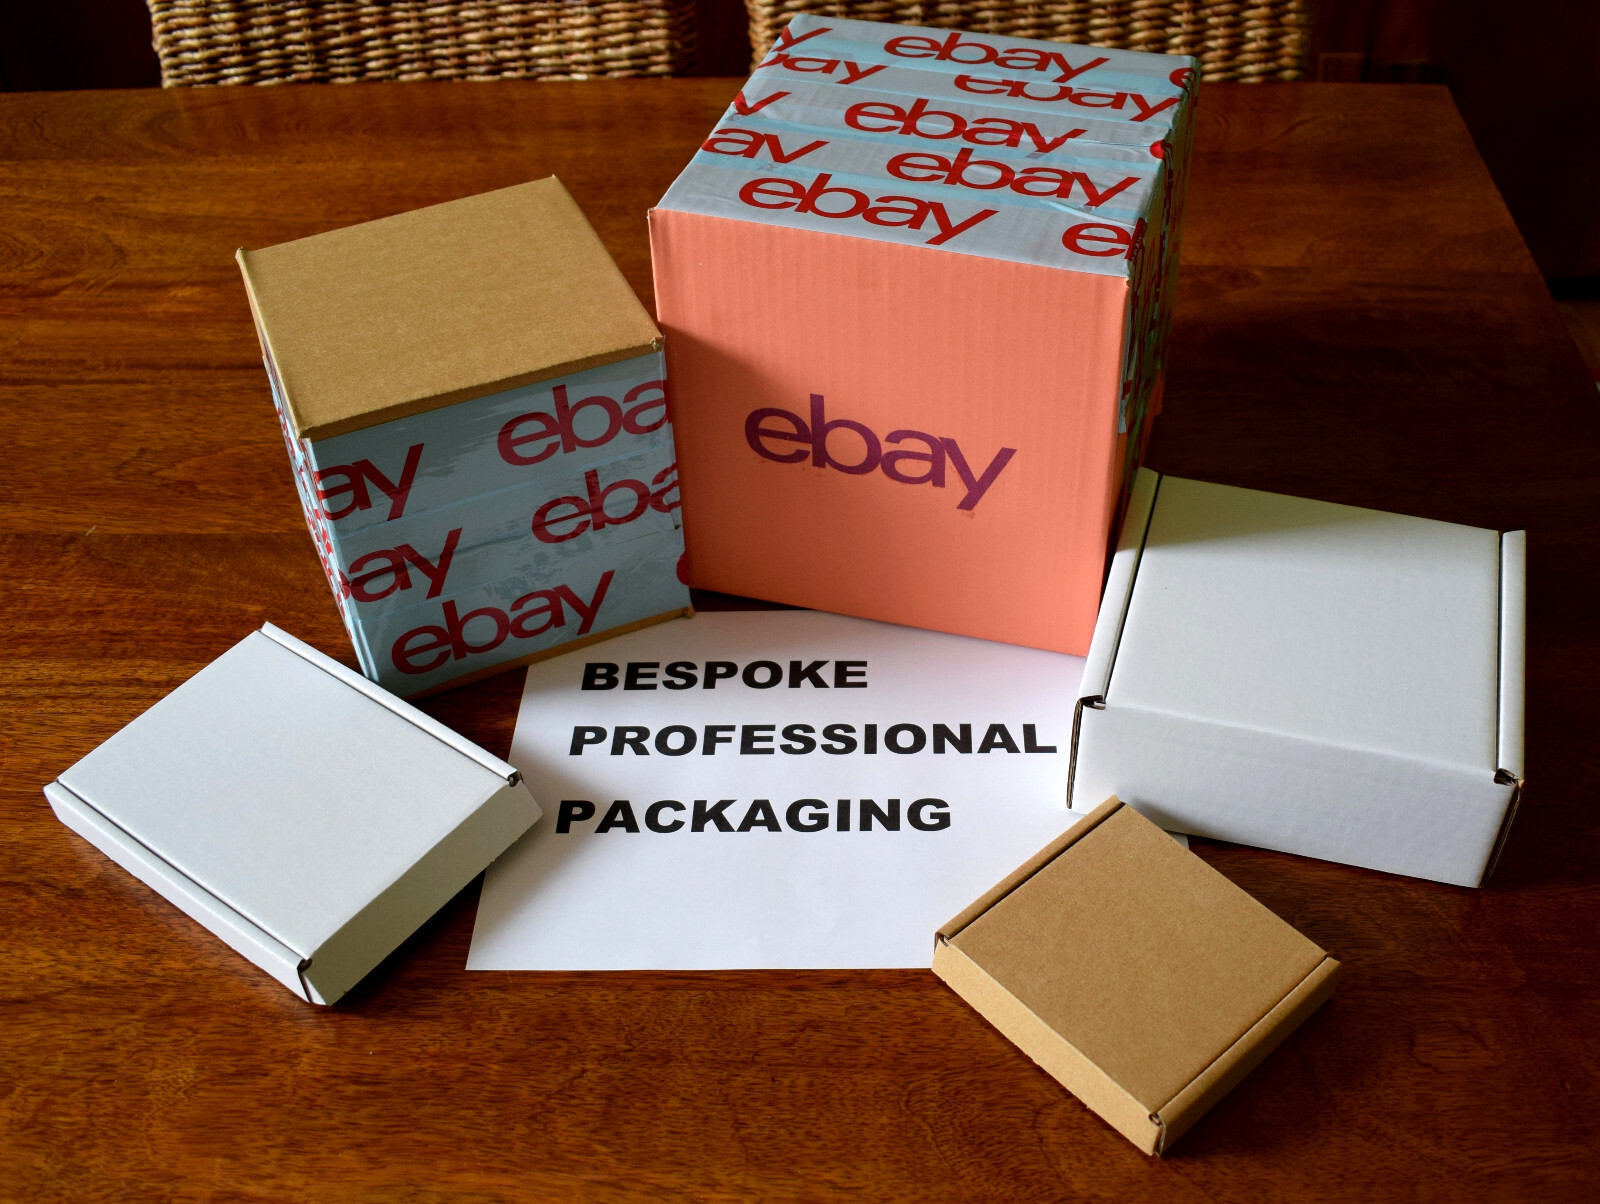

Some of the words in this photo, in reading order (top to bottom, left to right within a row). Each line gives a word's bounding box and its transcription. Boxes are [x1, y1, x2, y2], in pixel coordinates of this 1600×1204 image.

[884, 32, 1109, 84] ebay
[844, 98, 1088, 153] ebay
[886, 148, 1142, 207] ebay
[738, 173, 998, 245] ebay
[744, 393, 1017, 511] ebay
[391, 570, 615, 675] ebay
[580, 660, 868, 691] BESPOKE
[569, 723, 1058, 757] PROFESSIONAL
[555, 798, 952, 834] PACKAGING
